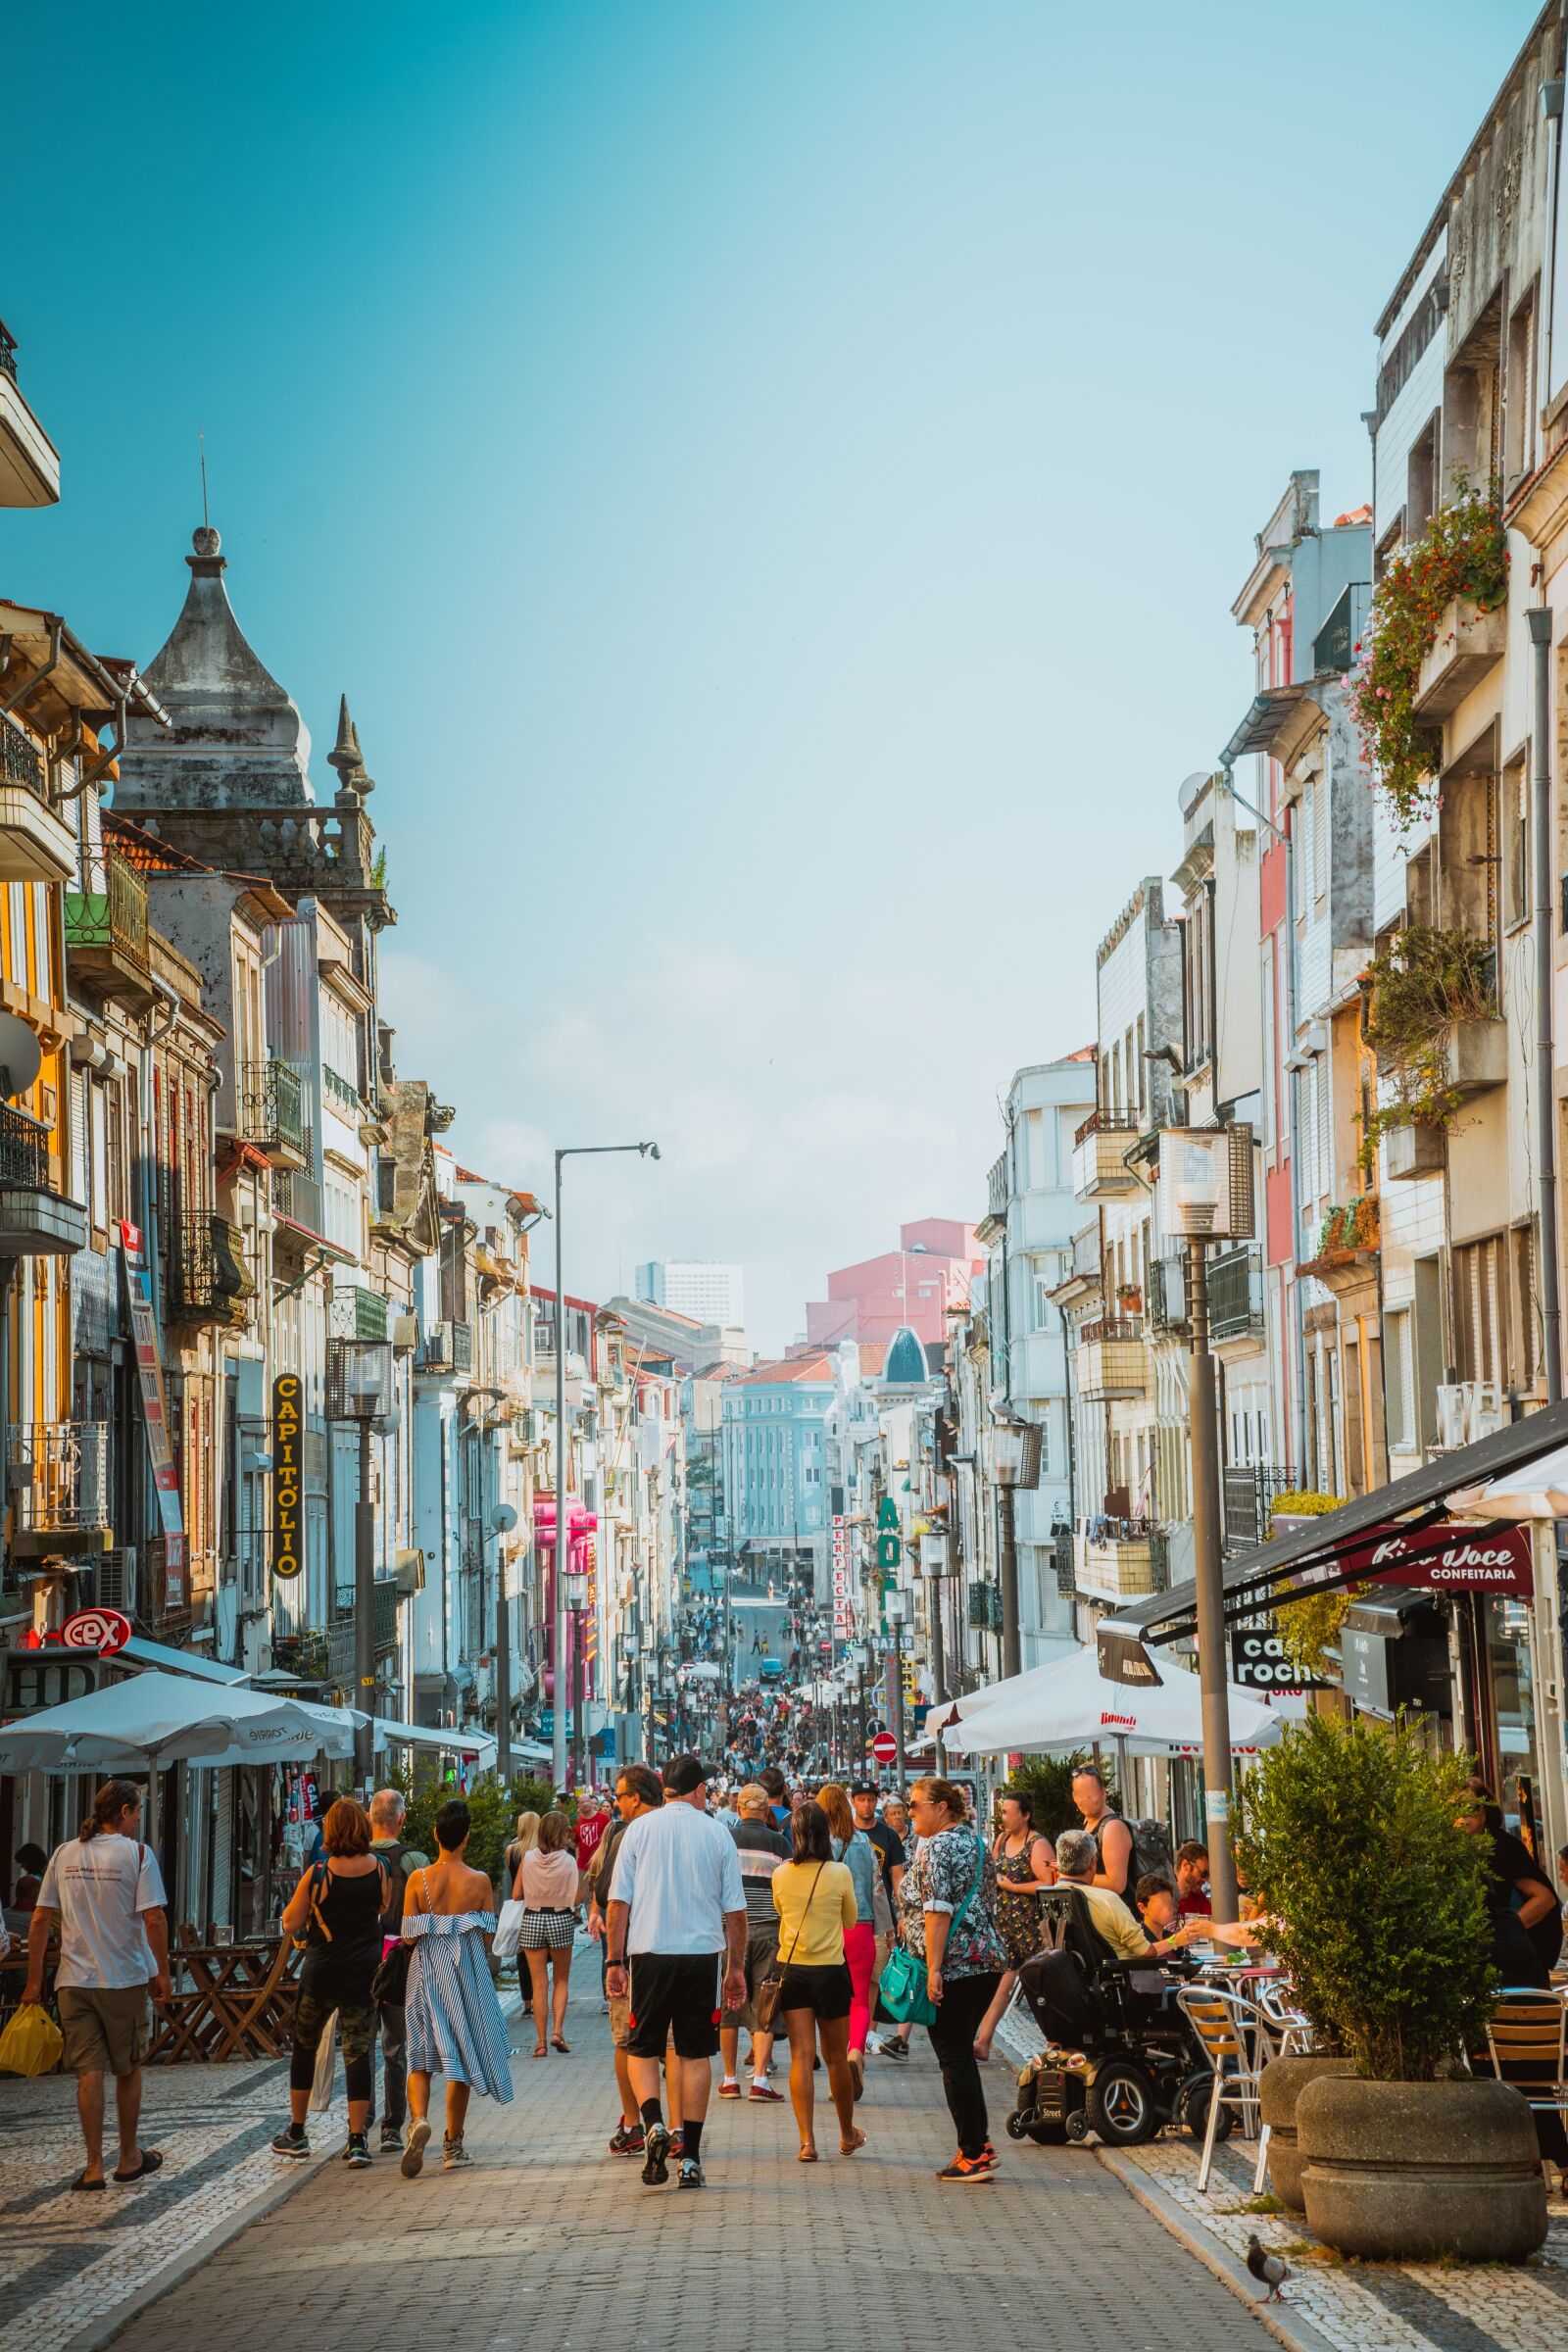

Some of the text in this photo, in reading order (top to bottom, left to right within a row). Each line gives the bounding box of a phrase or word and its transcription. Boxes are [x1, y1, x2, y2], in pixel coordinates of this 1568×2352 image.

[277, 1378, 299, 1575] CAPITÓLIO
[833, 1516, 844, 1623] PERFECTA
[1431, 1568, 1516, 1580] CONFEITARIA
[871, 1637, 913, 1650] BAZAR
[1238, 1658, 1322, 1683] roch
[1043, 2107, 1061, 2118] Street
